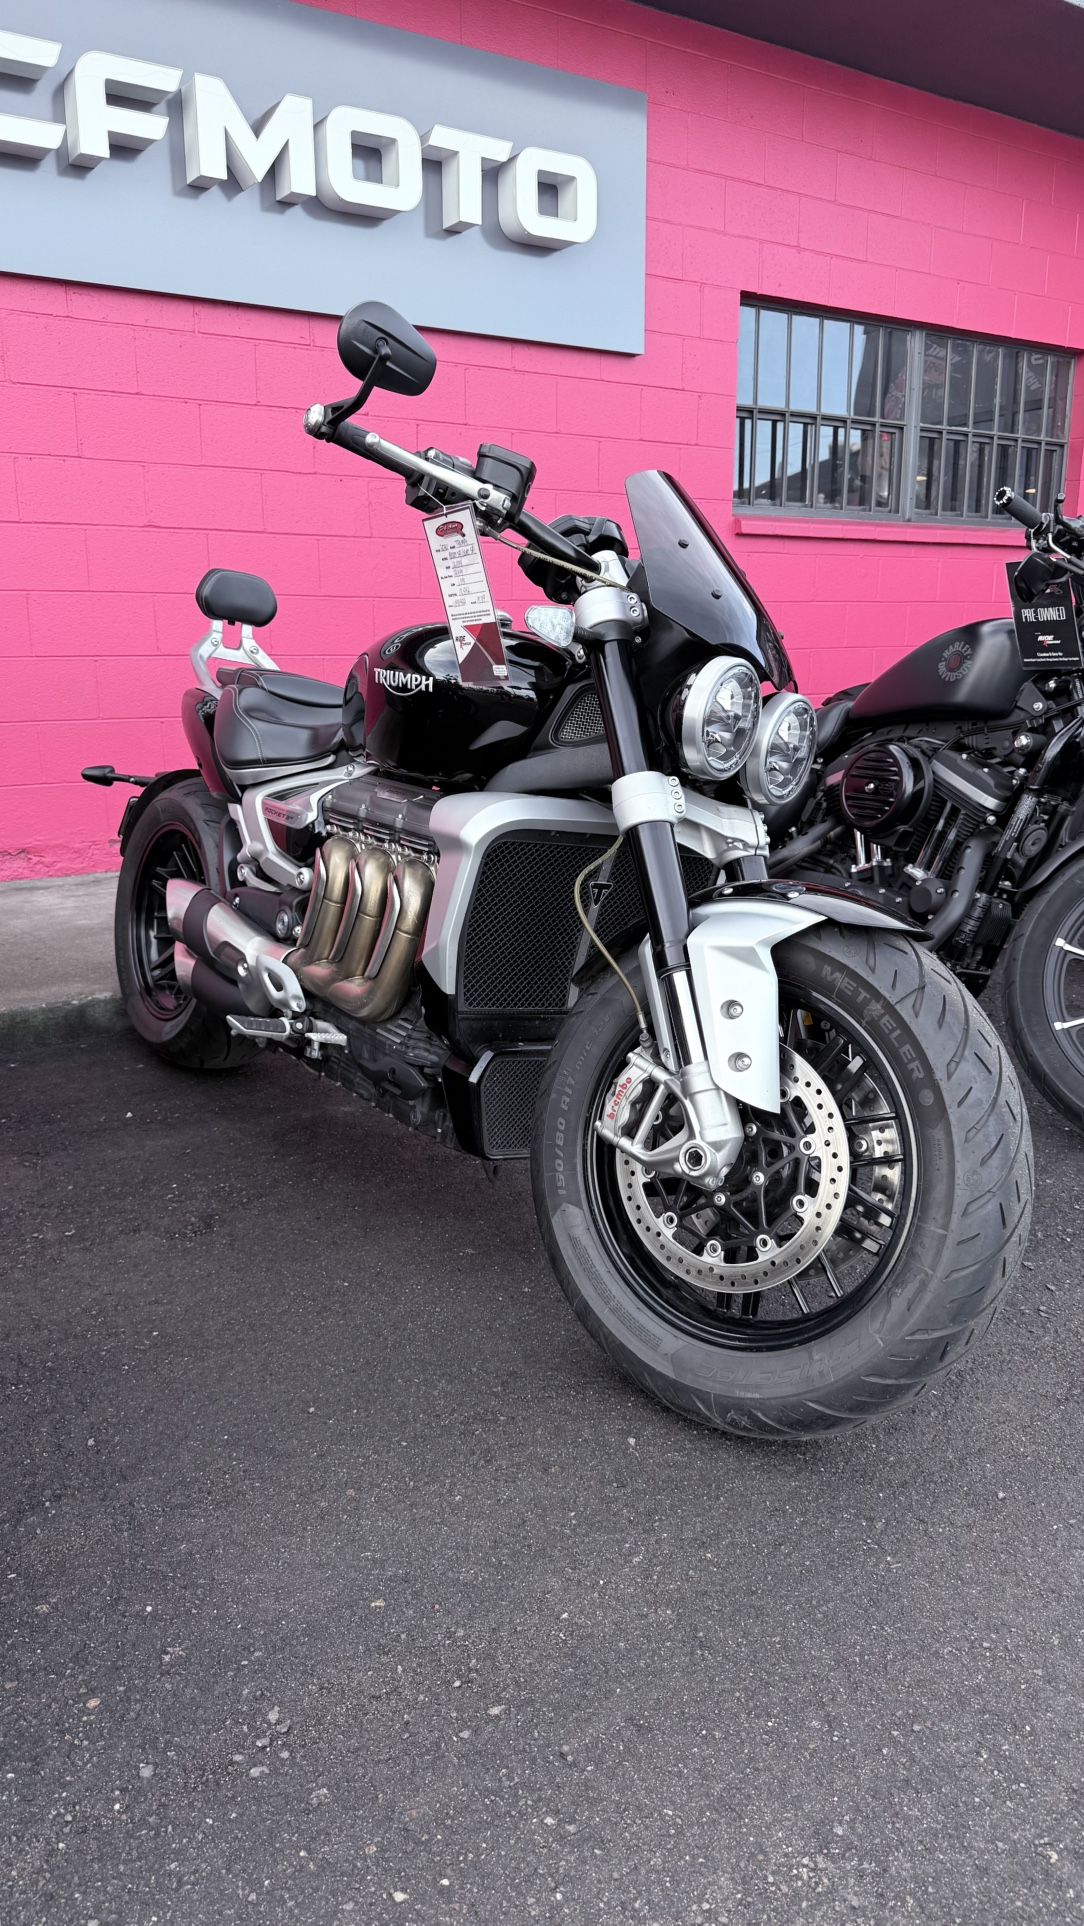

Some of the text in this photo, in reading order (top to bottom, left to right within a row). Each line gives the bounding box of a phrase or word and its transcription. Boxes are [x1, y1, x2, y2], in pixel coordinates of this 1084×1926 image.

[1021, 606, 1067, 623] PRE-OWNED
[942, 641, 973, 658] HARLEY
[373, 667, 433, 695] TRIUMPH
[937, 659, 973, 682] DAVIDSON
[607, 1077, 632, 1121] brembo
